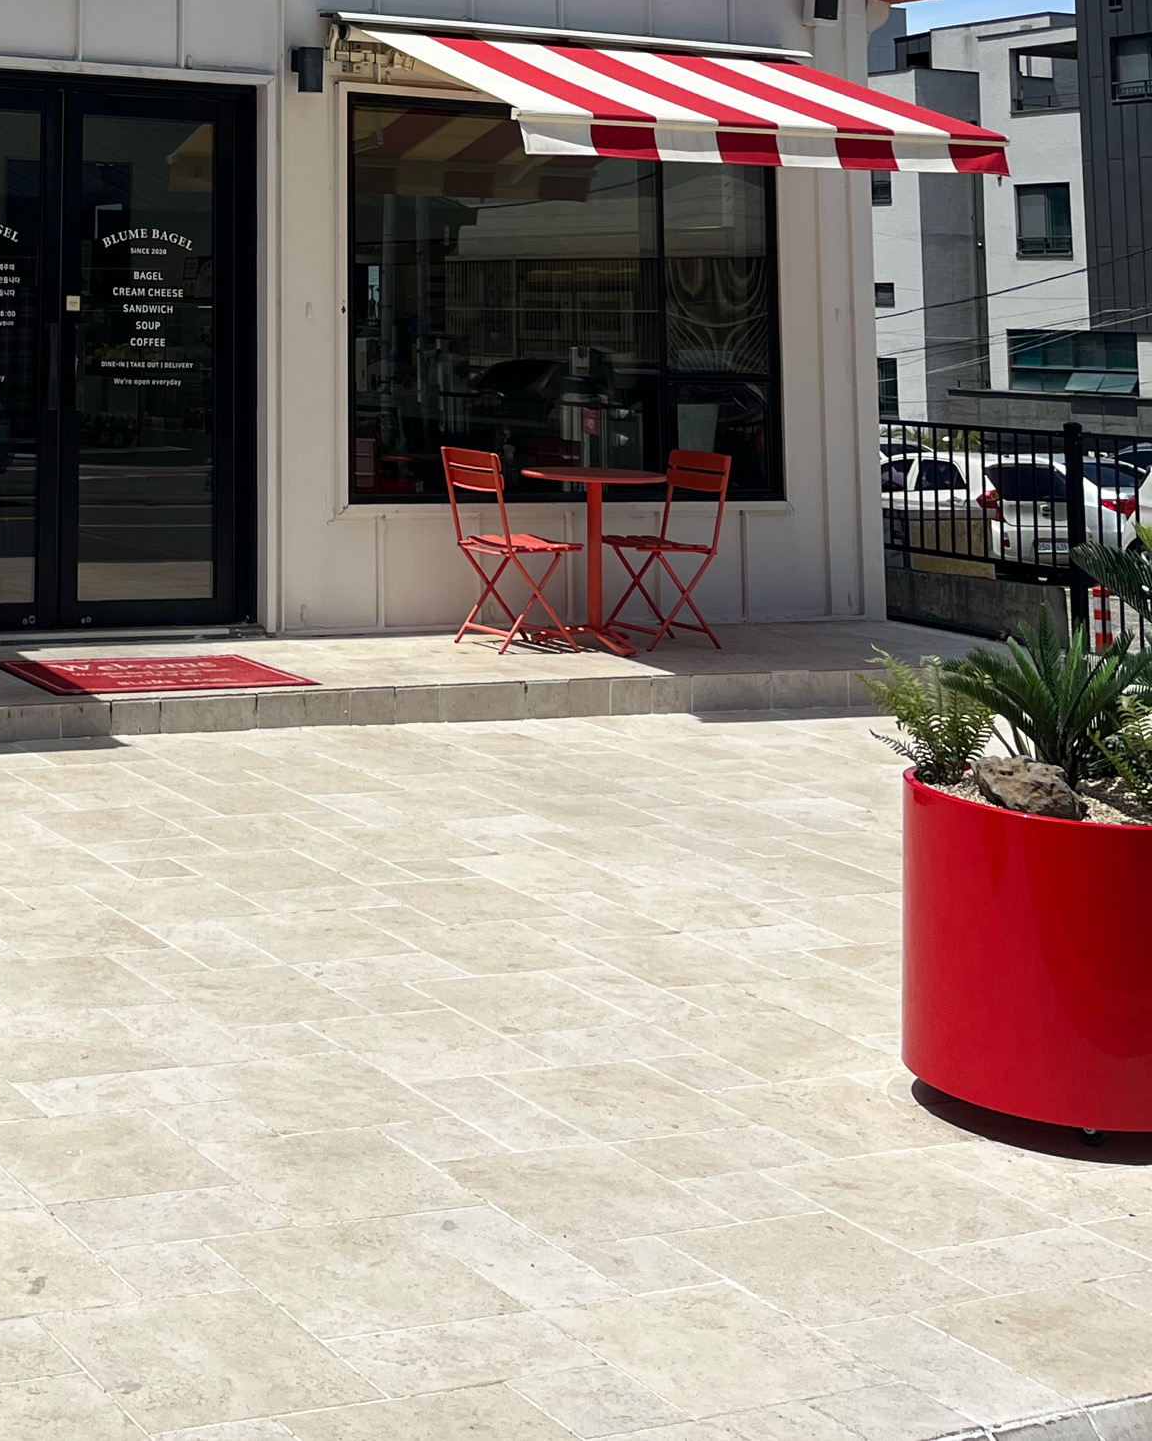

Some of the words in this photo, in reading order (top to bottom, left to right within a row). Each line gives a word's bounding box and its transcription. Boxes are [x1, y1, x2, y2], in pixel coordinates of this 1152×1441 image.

[102, 228, 148, 248] BLUME
[151, 228, 193, 251] BAGEL
[133, 271, 163, 280] BAGEL
[112, 287, 145, 296] CREAM
[148, 288, 184, 297] CHEESE
[123, 304, 173, 314] SANDWICH
[135, 321, 161, 330] SOUP
[130, 337, 166, 347] COFFEE
[152, 379, 182, 387] everyday
[49, 660, 216, 672] Welcome
